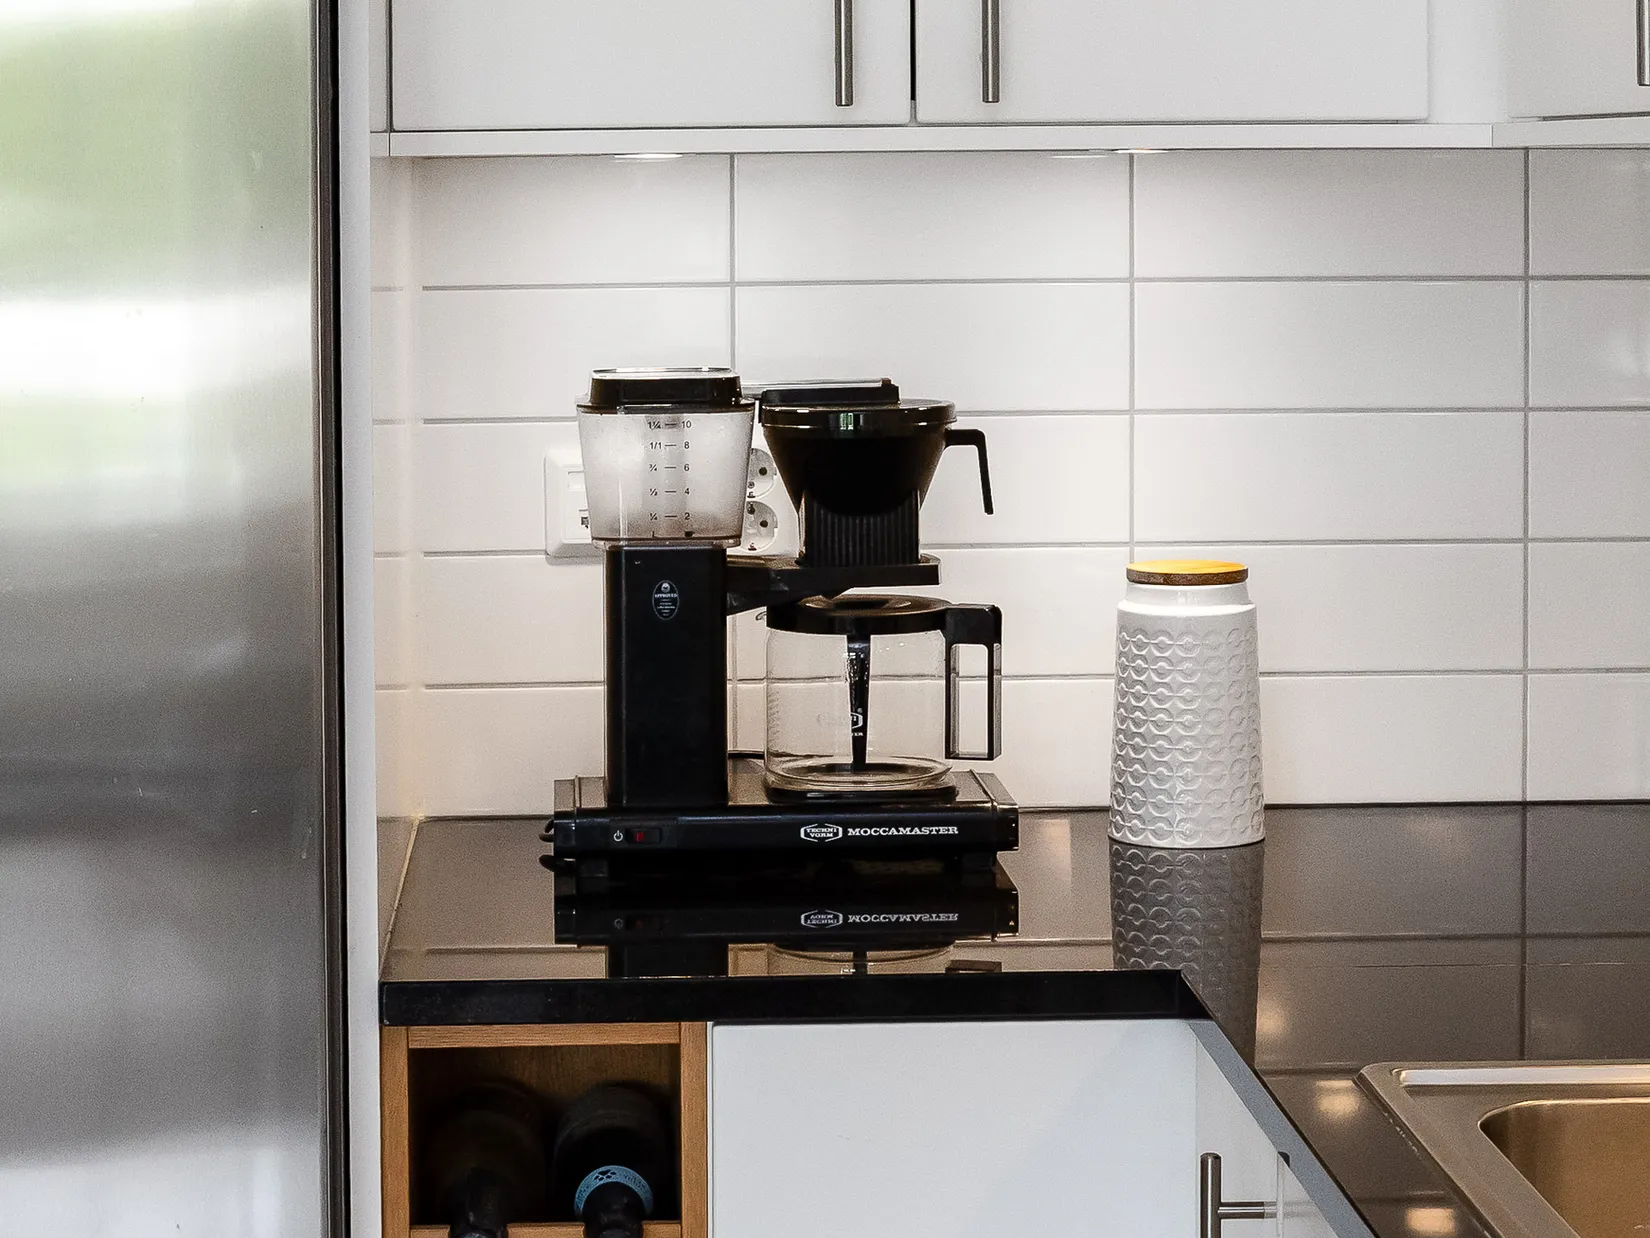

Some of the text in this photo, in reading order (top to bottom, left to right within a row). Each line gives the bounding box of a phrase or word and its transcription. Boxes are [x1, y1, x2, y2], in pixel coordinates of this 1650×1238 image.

[681, 420, 692, 429] 10
[649, 441, 690, 450] 1/1 8
[683, 463, 690, 472] 6
[684, 487, 690, 495] 4
[684, 512, 690, 521] 2
[847, 826, 959, 836] MOCCAMASTER
